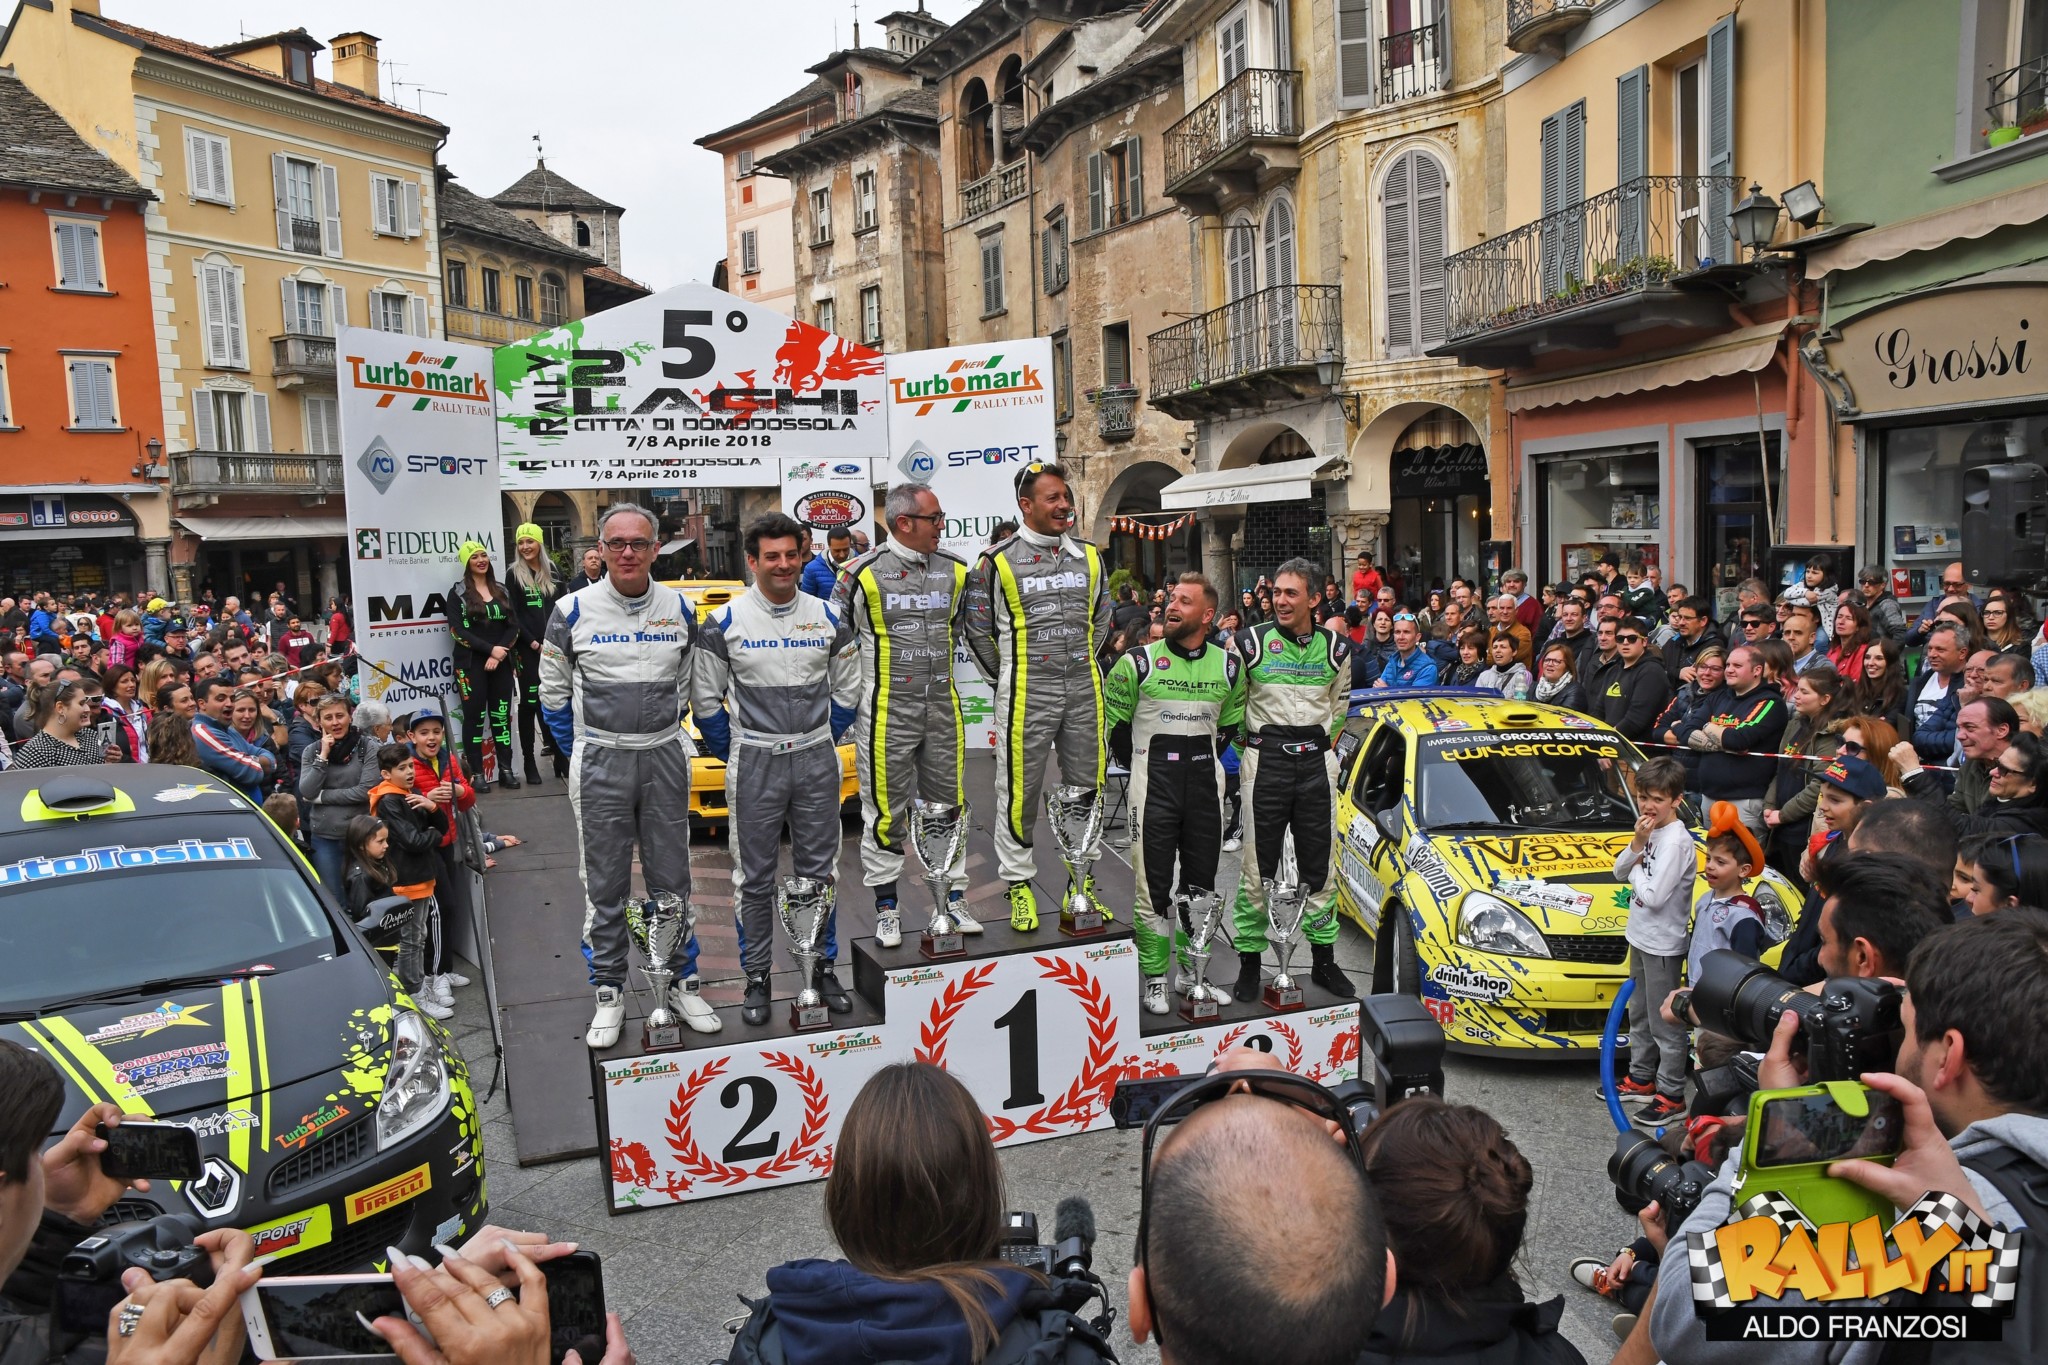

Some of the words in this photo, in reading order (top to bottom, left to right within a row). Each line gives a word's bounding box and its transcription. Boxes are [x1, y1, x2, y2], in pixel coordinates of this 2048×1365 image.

[661, 309, 748, 380] 5°
[420, 356, 443, 366] NEW
[1875, 319, 2032, 389] Grossi
[961, 359, 987, 370] NEW
[526, 352, 568, 436] RALLY
[572, 387, 859, 415] LAGHI
[432, 401, 464, 415] RALLY
[466, 404, 491, 416] TEAM
[974, 398, 1010, 410] RALLY
[1011, 395, 1044, 406] TEAM
[653, 418, 675, 431] DI
[683, 418, 858, 431] DOMODOSSOLA
[626, 436, 658, 451] 7/8
[663, 435, 720, 450] Aprile
[725, 435, 772, 448] 2018
[912, 457, 934, 471] ACI
[948, 445, 1040, 467] SPORT
[372, 457, 394, 474] ACI
[407, 455, 488, 476] SPORT
[838, 465, 855, 473] Ford
[589, 470, 613, 481] 7/8
[617, 470, 659, 481] Aprile
[663, 470, 697, 478] 2018
[388, 557, 408, 565] Private
[410, 556, 430, 565] Banker
[370, 626, 449, 638] PERFORMANC
[590, 632, 630, 645] Auto
[634, 631, 678, 644] Tosini
[740, 638, 779, 649] Auto
[782, 636, 826, 648] Tosini
[1427, 737, 1471, 747] IMPRESA
[1473, 734, 1498, 743] EDILE
[1500, 731, 1553, 741] GROSSI
[1555, 732, 1620, 744] SEVERINO
[0, 838, 260, 887] utoTosini
[1507, 861, 1614, 875] www.valdi
[1472, 974, 1508, 995] shop
[1447, 987, 1490, 1000] DOMODOSSOLA
[112, 1042, 227, 1072] COMBUSTIBILI
[994, 988, 1045, 1111] 1
[130, 1051, 230, 1081] FERRARI
[606, 1062, 681, 1080] urbomark
[719, 1075, 780, 1164] 2
[354, 1171, 424, 1216] PIRELLI
